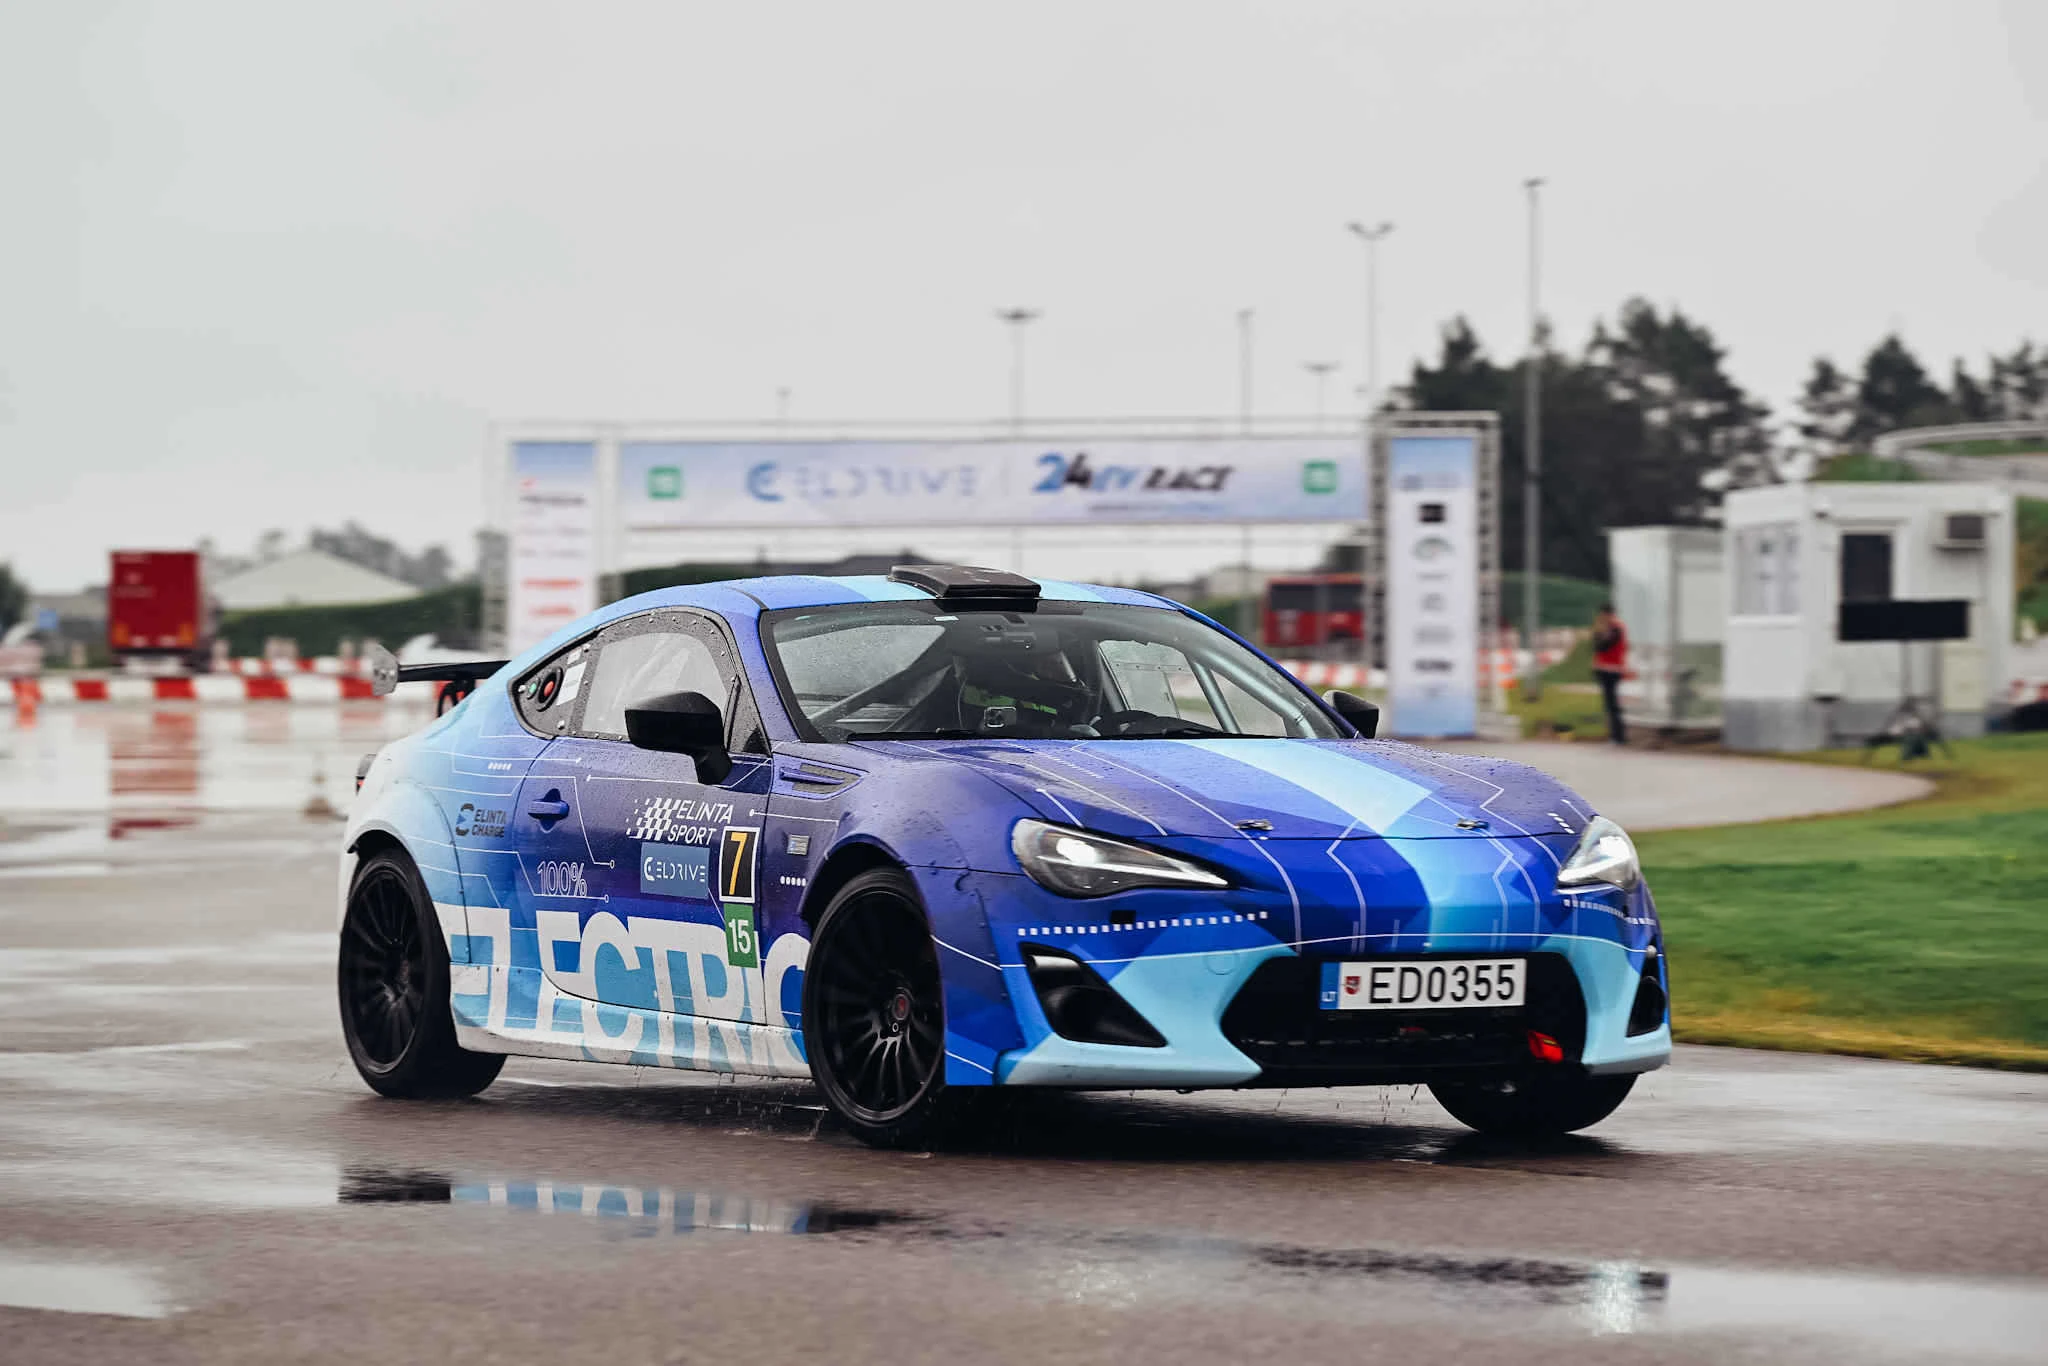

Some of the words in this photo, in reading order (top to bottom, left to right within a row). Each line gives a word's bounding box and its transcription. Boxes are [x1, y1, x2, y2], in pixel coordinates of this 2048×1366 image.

[474, 809, 506, 823] ELINTA
[676, 800, 734, 824] ELINTA
[471, 824, 505, 838] CHARGE
[667, 824, 717, 846] SPORT
[656, 861, 706, 882] ELDRIVE
[729, 832, 748, 895] 7
[537, 861, 587, 897] 100%
[728, 919, 750, 954] 15
[1369, 964, 1515, 1004] ED0355
